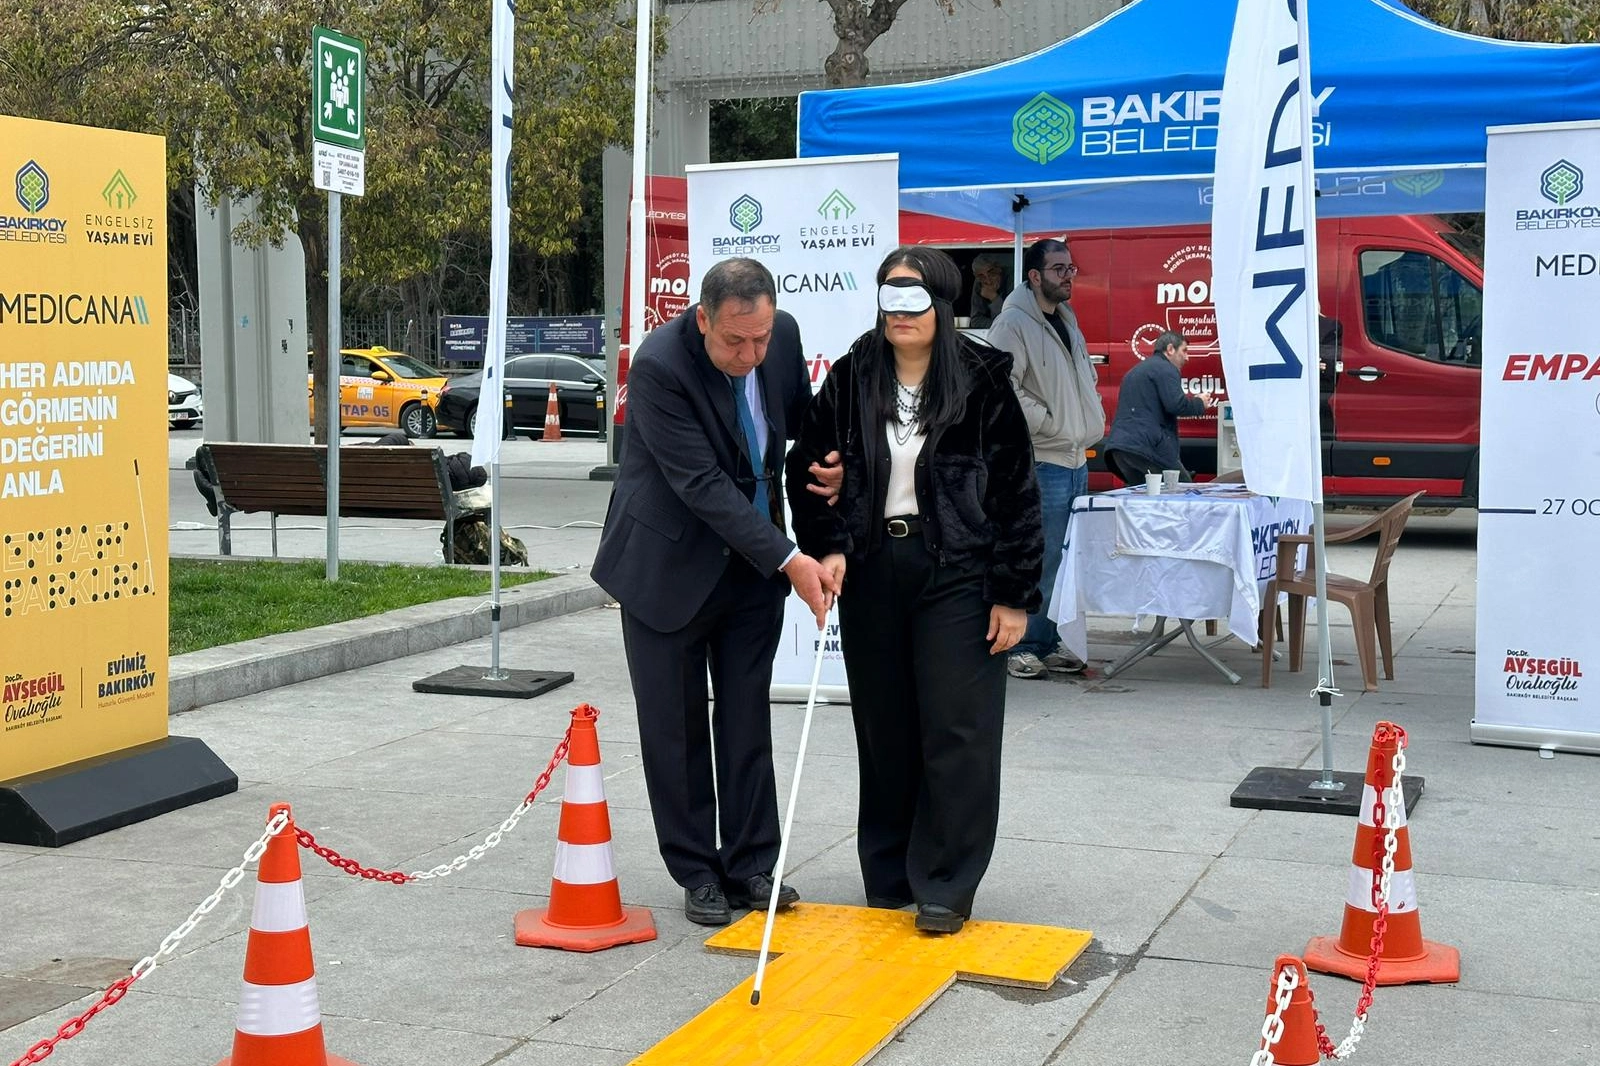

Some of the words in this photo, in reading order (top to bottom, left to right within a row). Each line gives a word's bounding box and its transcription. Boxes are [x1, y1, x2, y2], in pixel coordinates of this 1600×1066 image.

[85, 214, 154, 230] ENGELSİZ
[800, 224, 875, 237] ENGELSİZ
[86, 230, 129, 246] YAŞAM
[134, 231, 154, 246] EVİ
[801, 239, 847, 250] YAŞAM
[852, 236, 875, 247] EVİ
[1536, 253, 1600, 277] MED
[777, 272, 845, 294] ICANA
[0, 293, 136, 325] MEDICANA
[0, 362, 46, 389] HER
[52, 360, 136, 387] ADIMDA
[1181, 374, 1225, 395] EGÜL
[0, 388, 118, 426] GÖRMENİN
[373, 405, 389, 418] 05
[0, 424, 104, 464] DEĞERİNİ
[1, 468, 65, 499] ANLA
[1542, 498, 1565, 515] 27
[107, 652, 147, 677] EVİMİZ
[1503, 656, 1583, 678] AYŞEGÜL
[2, 672, 65, 704] AYŞEGÜL
[98, 670, 156, 699] BAKIRKÖY
[1506, 674, 1578, 696] Ovalıoğlu
[5, 692, 62, 723] Ovalıoğlu
